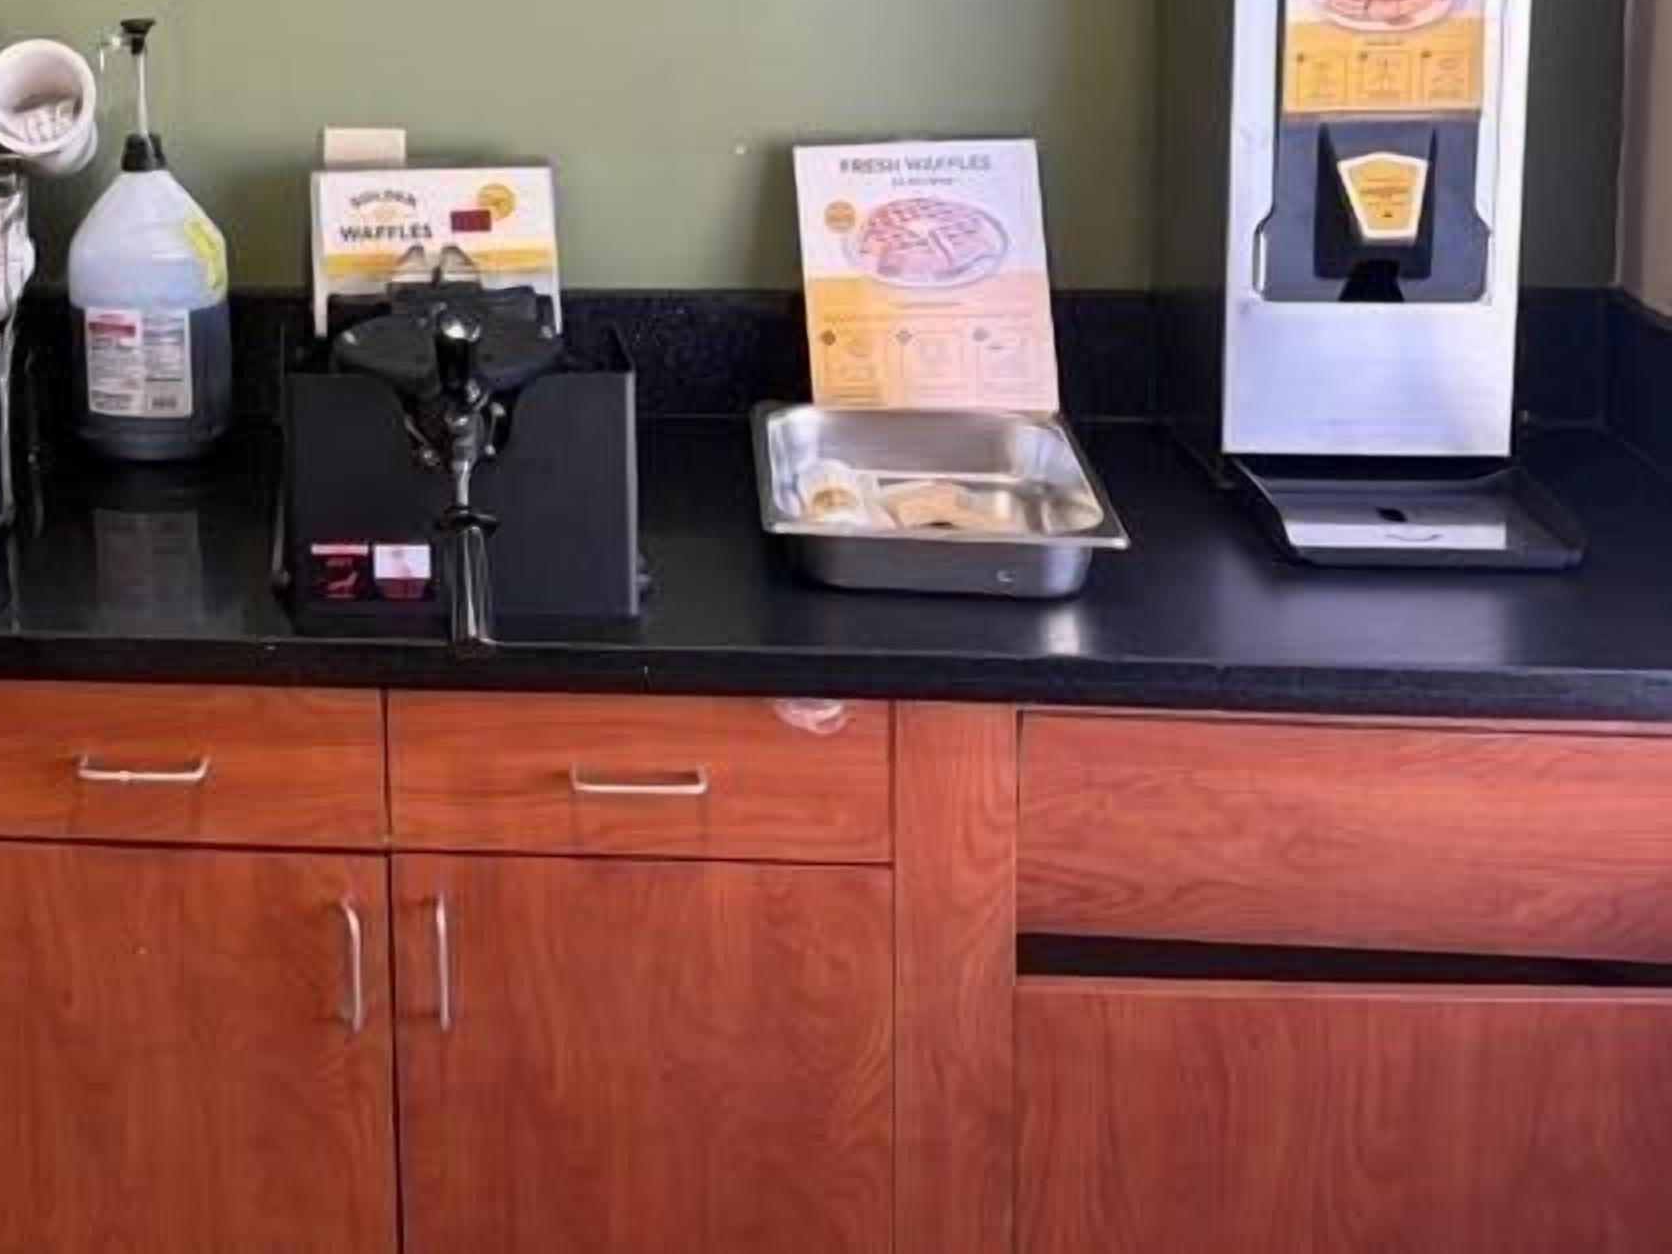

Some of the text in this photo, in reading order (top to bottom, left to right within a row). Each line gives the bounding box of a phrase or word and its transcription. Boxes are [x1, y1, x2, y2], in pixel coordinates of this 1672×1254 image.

[839, 154, 992, 173] FRESH WAFFLES
[340, 223, 433, 242] WAFFLES
